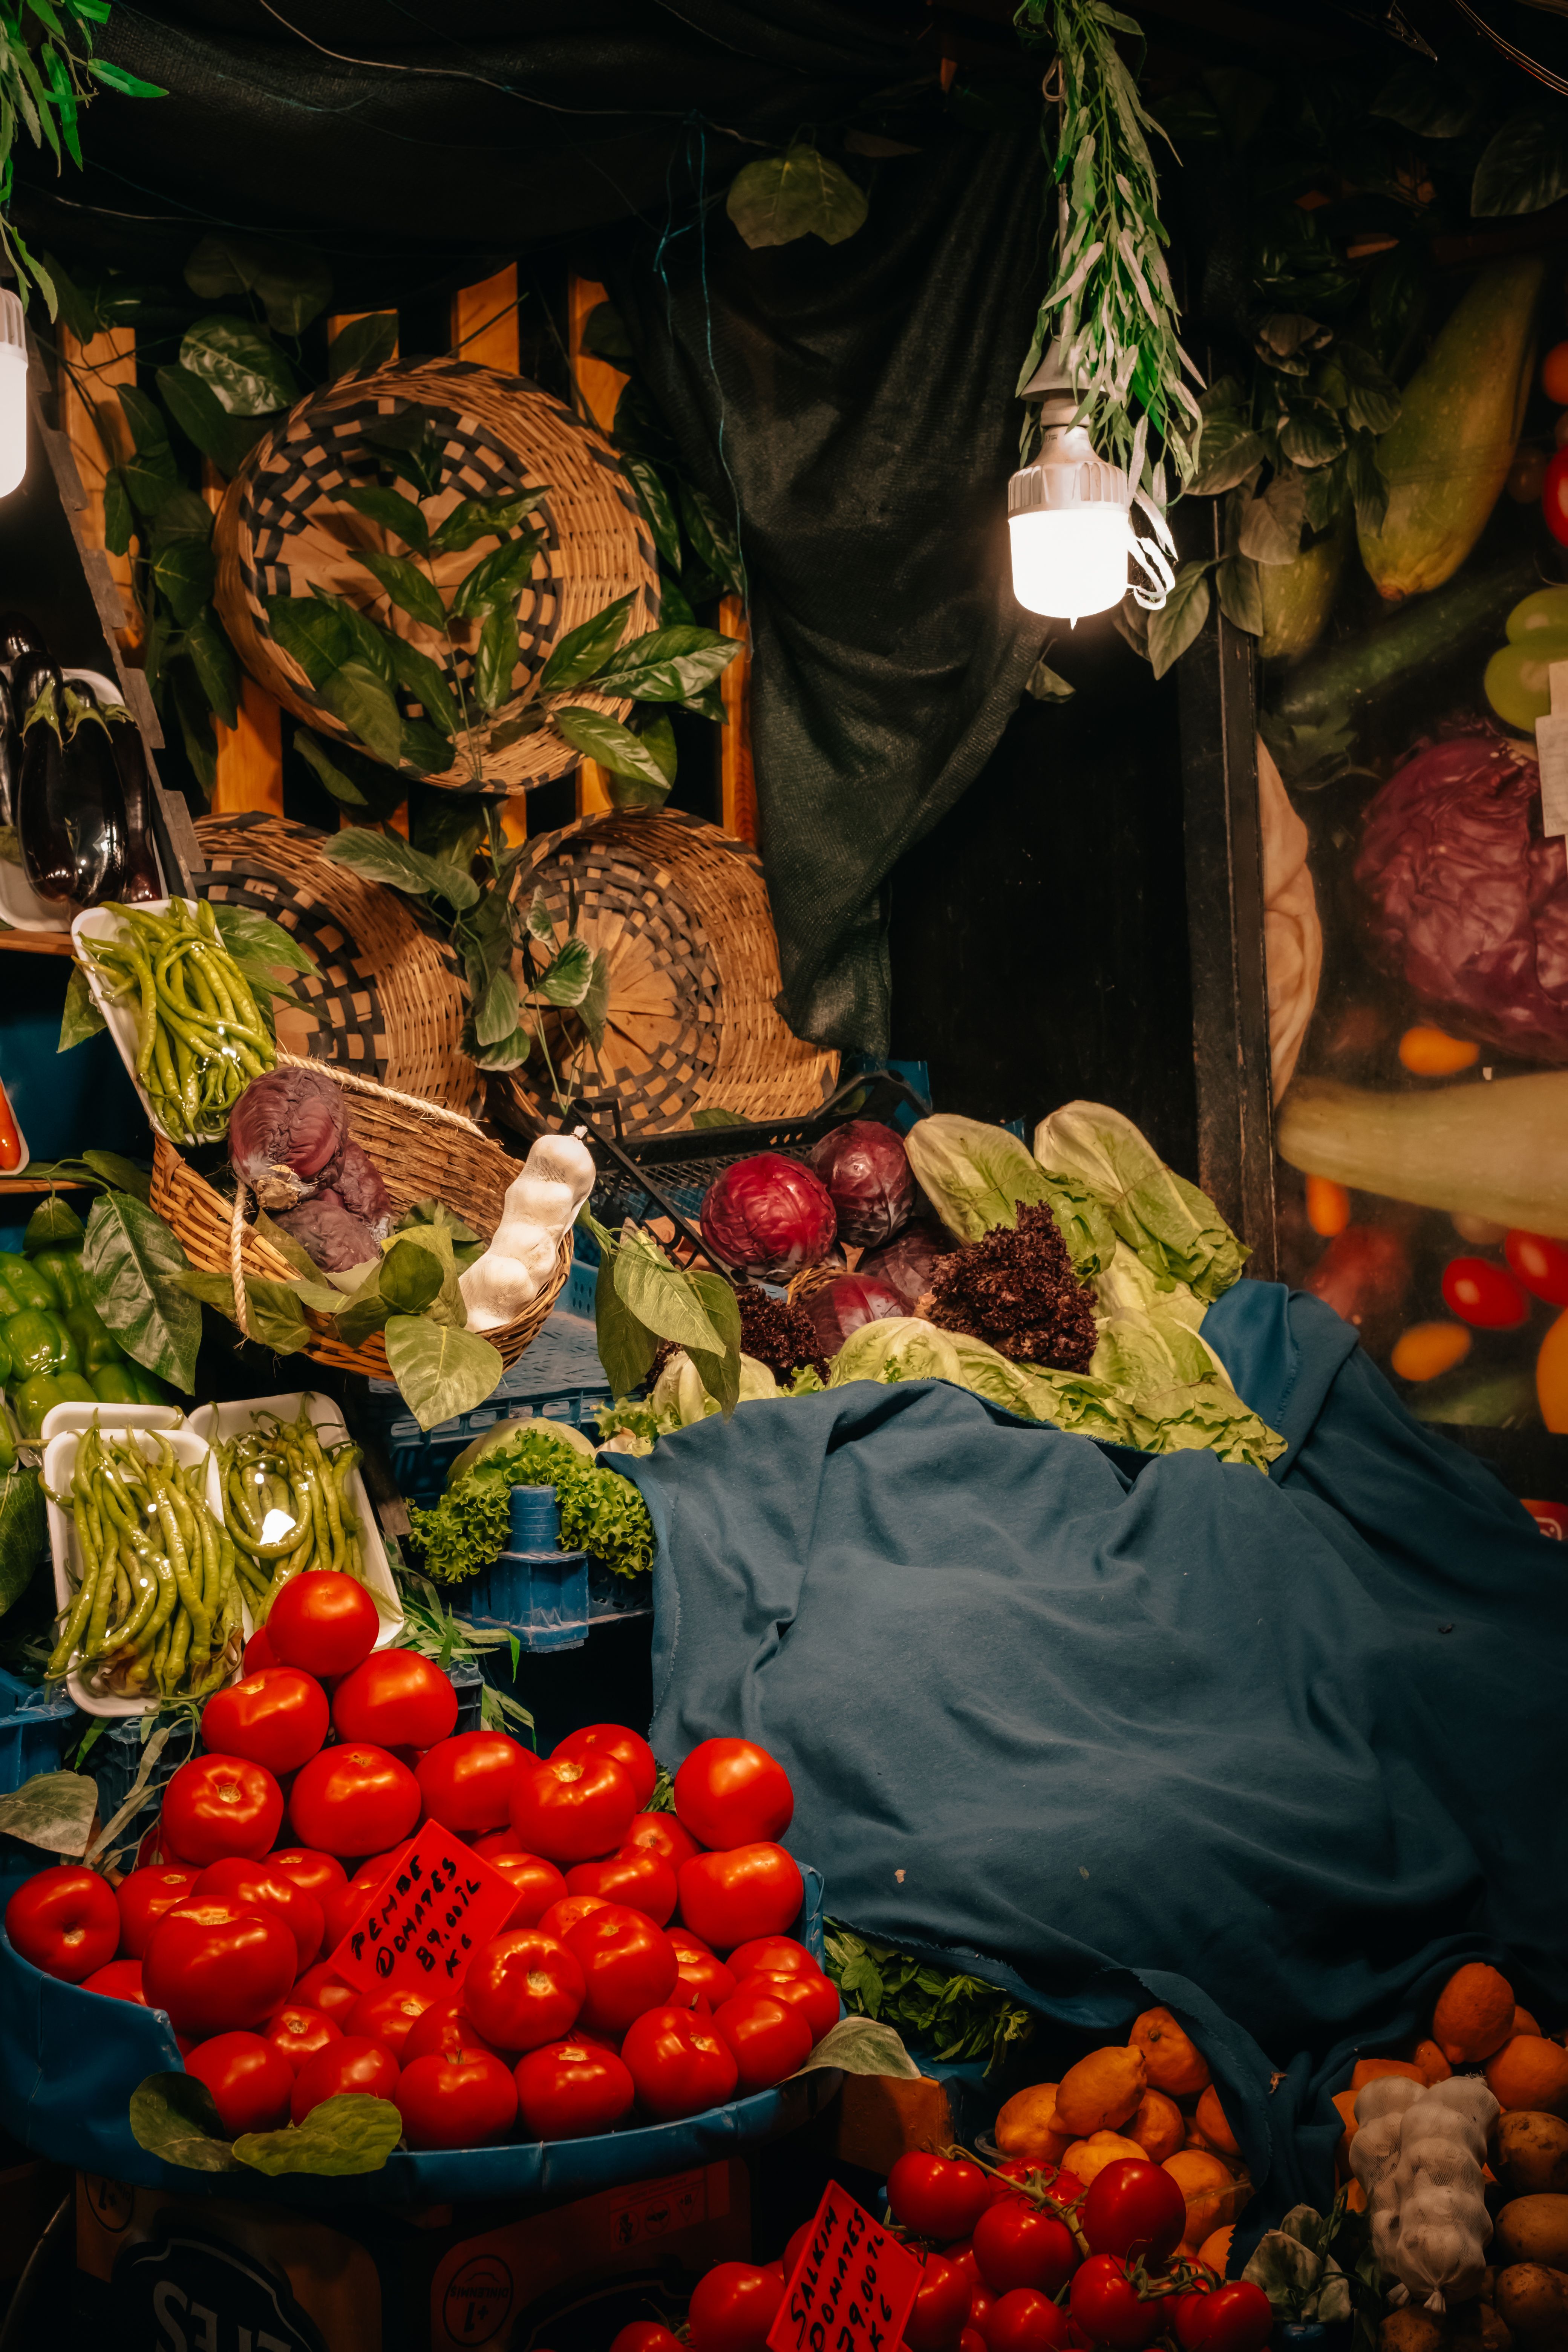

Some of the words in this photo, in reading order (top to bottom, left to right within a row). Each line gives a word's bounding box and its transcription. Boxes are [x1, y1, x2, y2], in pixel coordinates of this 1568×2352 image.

[351, 1856, 422, 1960] PEMBE
[376, 1857, 456, 1977] DOMATES
[464, 2302, 489, 2332] +1
[809, 2207, 866, 2352] DOMATES
